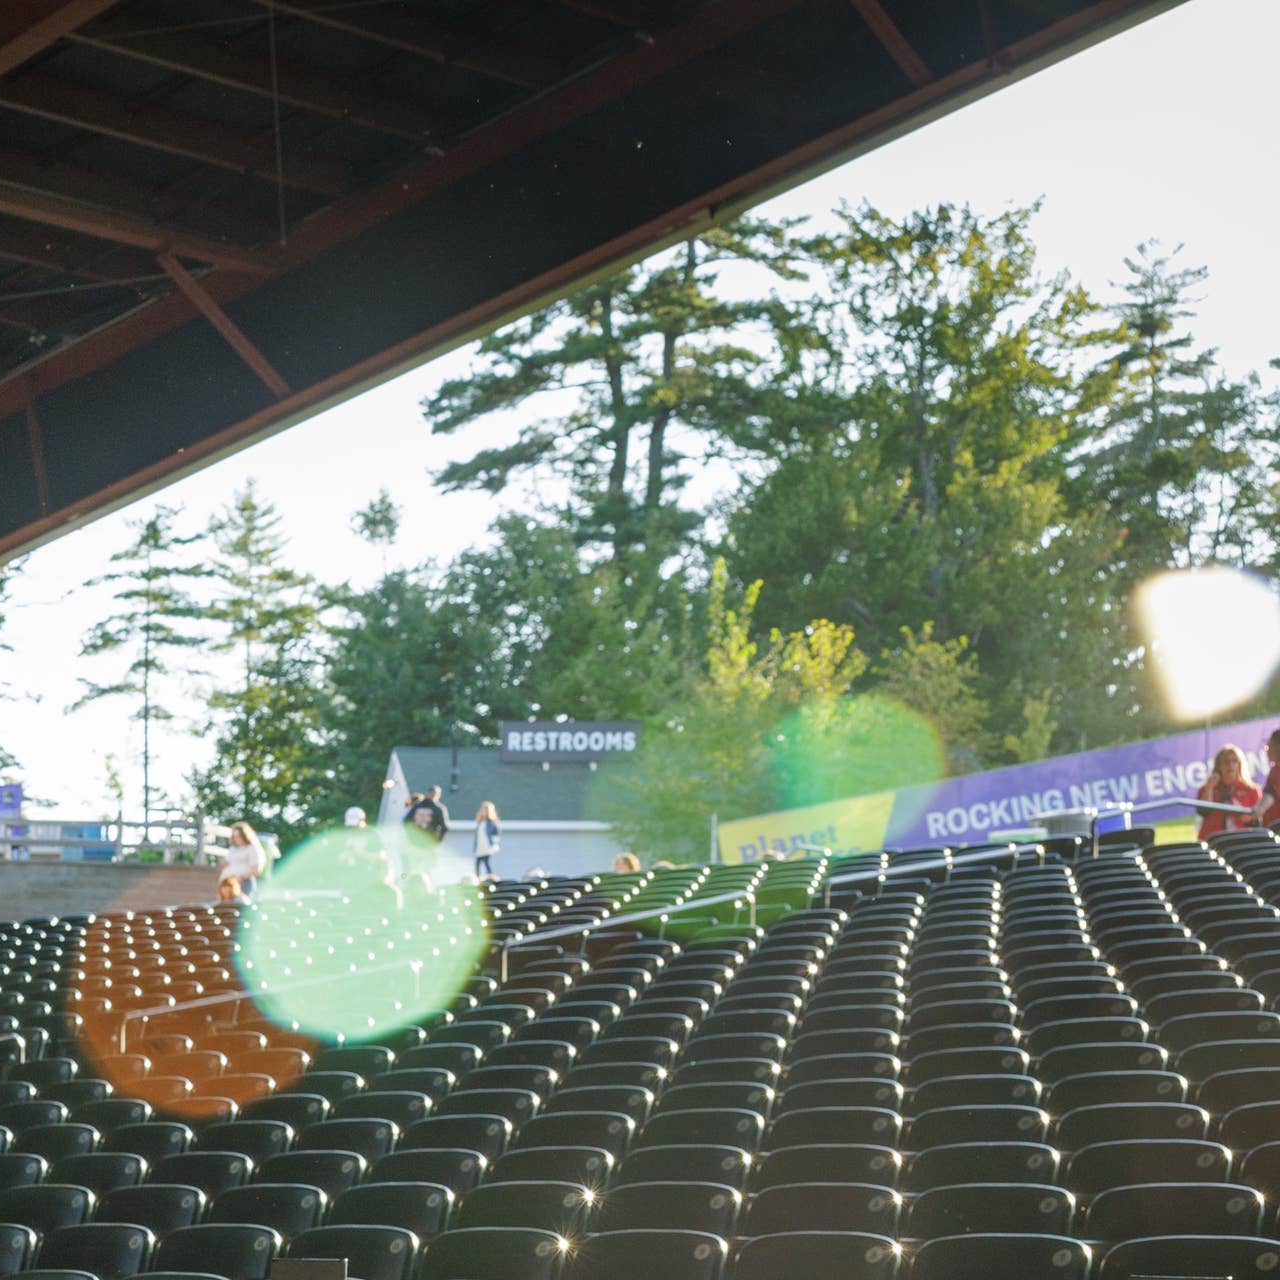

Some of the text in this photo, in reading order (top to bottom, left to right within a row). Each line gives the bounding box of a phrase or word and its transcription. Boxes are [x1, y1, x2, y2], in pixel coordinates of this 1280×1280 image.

[507, 731, 636, 752] RESTROOMS
[926, 788, 1067, 838] ROCKING
[1068, 773, 1140, 809] NEW
[739, 824, 838, 864] planet
